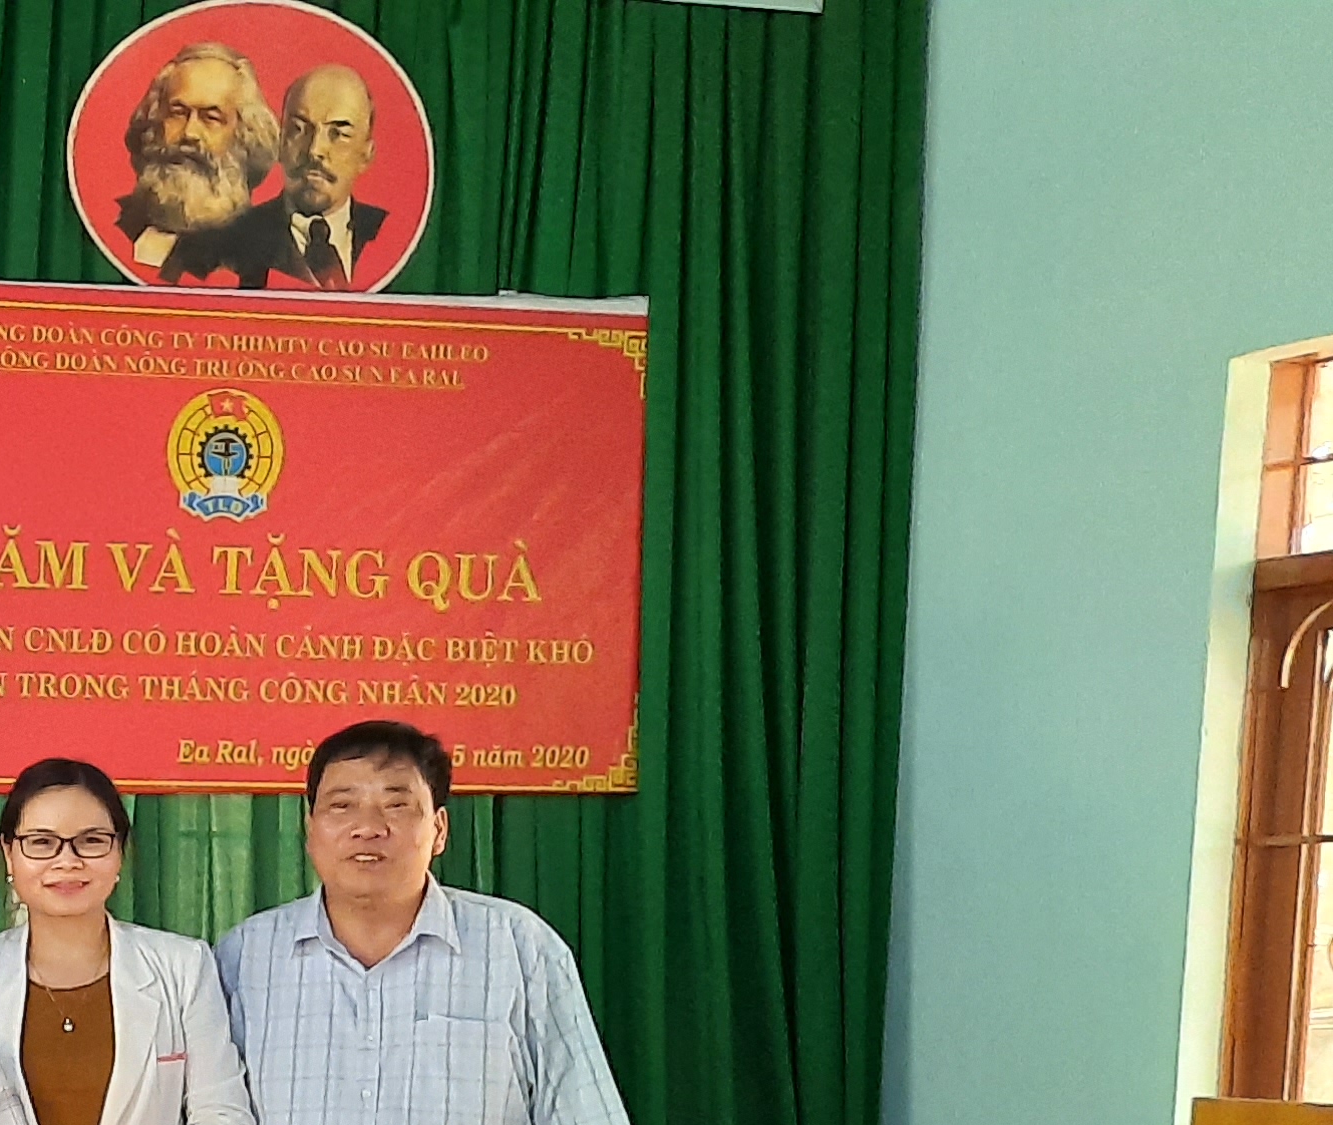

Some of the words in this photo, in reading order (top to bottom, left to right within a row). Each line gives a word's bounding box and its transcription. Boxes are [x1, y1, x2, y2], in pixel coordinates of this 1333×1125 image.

[100, 324, 164, 348] CÔNG
[172, 331, 195, 350] TY
[318, 339, 363, 357] CAO
[370, 341, 395, 358] SU
[125, 351, 186, 375] NÔNG
[291, 363, 336, 380] CAO
[106, 527, 196, 593] VÀ
[212, 533, 390, 610] TẶNG
[406, 538, 542, 613] QUÀ
[24, 626, 112, 654] CNLĐ
[122, 624, 166, 655] CÓ
[175, 625, 266, 658] HOÀN
[445, 630, 520, 667] BIỆT
[15, 672, 129, 700] TRONG
[138, 670, 249, 702] THÁNG
[259, 672, 348, 705] CÔNG
[454, 683, 517, 706] 2020
[177, 739, 210, 763] Ea
[271, 739, 316, 771] ngà
[472, 744, 523, 768] năm
[530, 745, 590, 768] 2020
